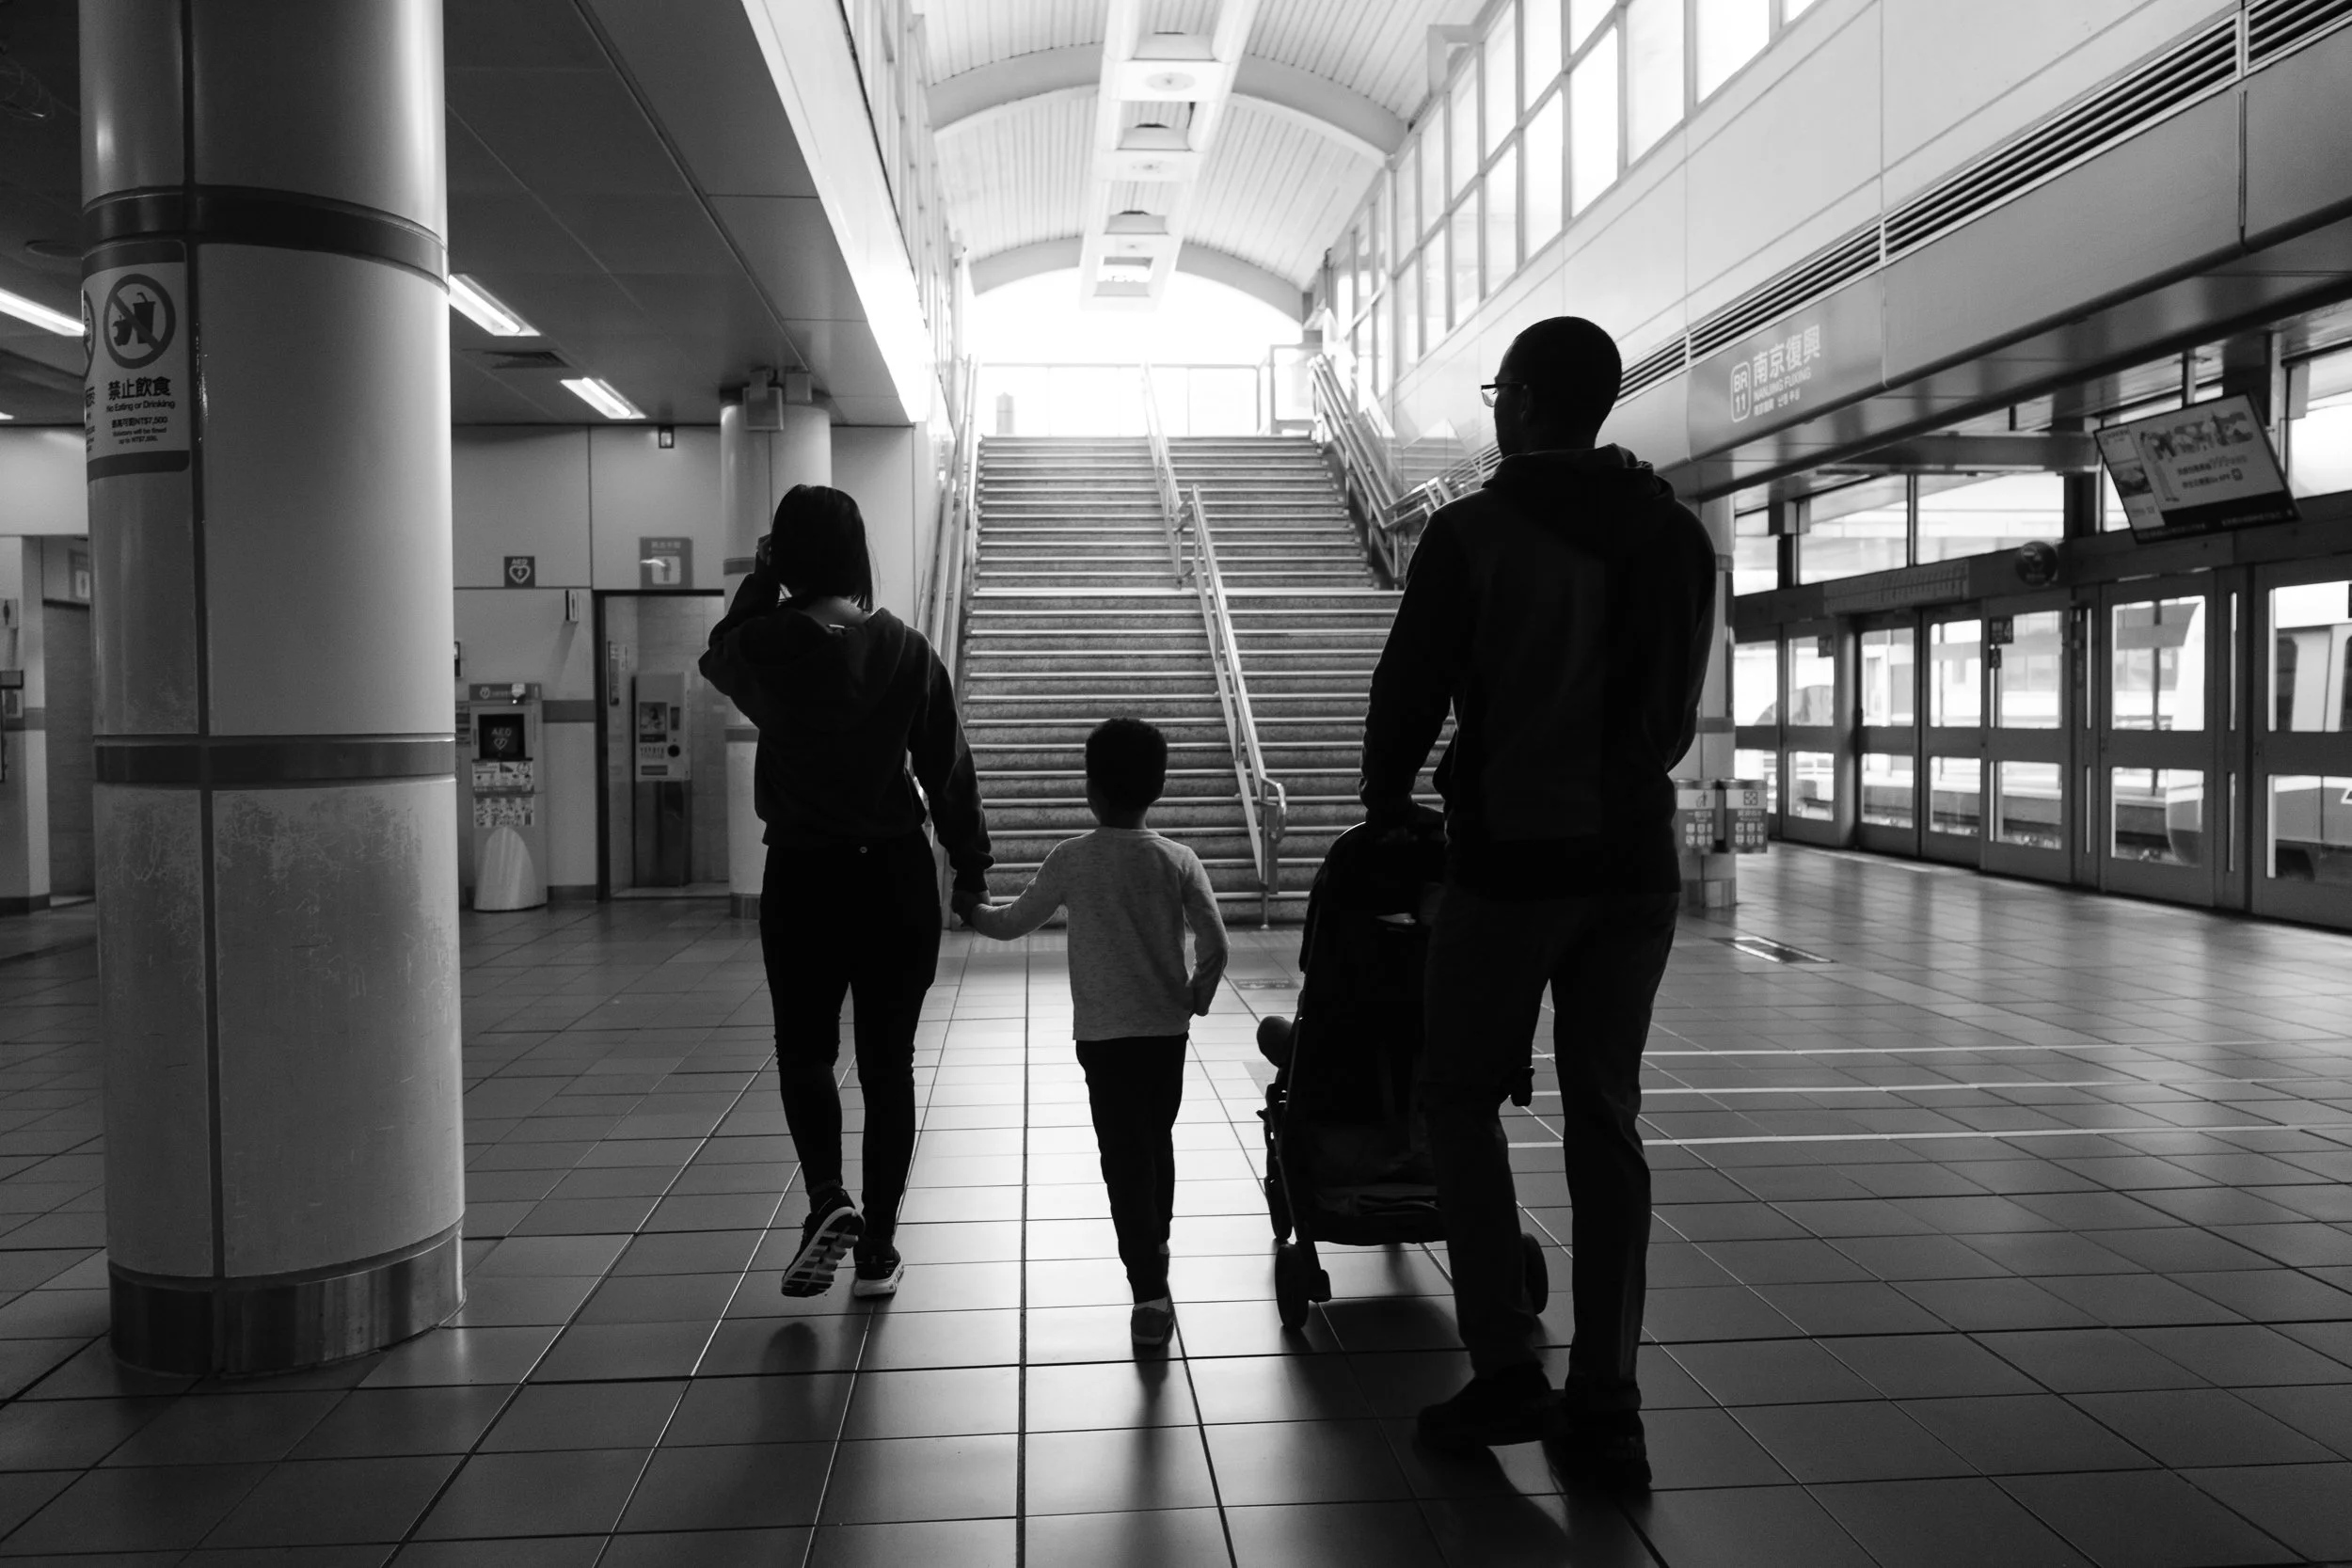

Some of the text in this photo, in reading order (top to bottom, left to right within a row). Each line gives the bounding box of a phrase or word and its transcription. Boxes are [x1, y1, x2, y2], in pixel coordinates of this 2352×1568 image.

[1753, 324, 1820, 387] 南京復興
[1734, 371, 1748, 393] BR
[1784, 366, 1811, 388] FUXING
[108, 376, 171, 401] 禁止飲食
[115, 403, 134, 411] Eating
[143, 400, 176, 409] Drinking
[1735, 392, 1746, 413] 11
[491, 727, 513, 737] AED
